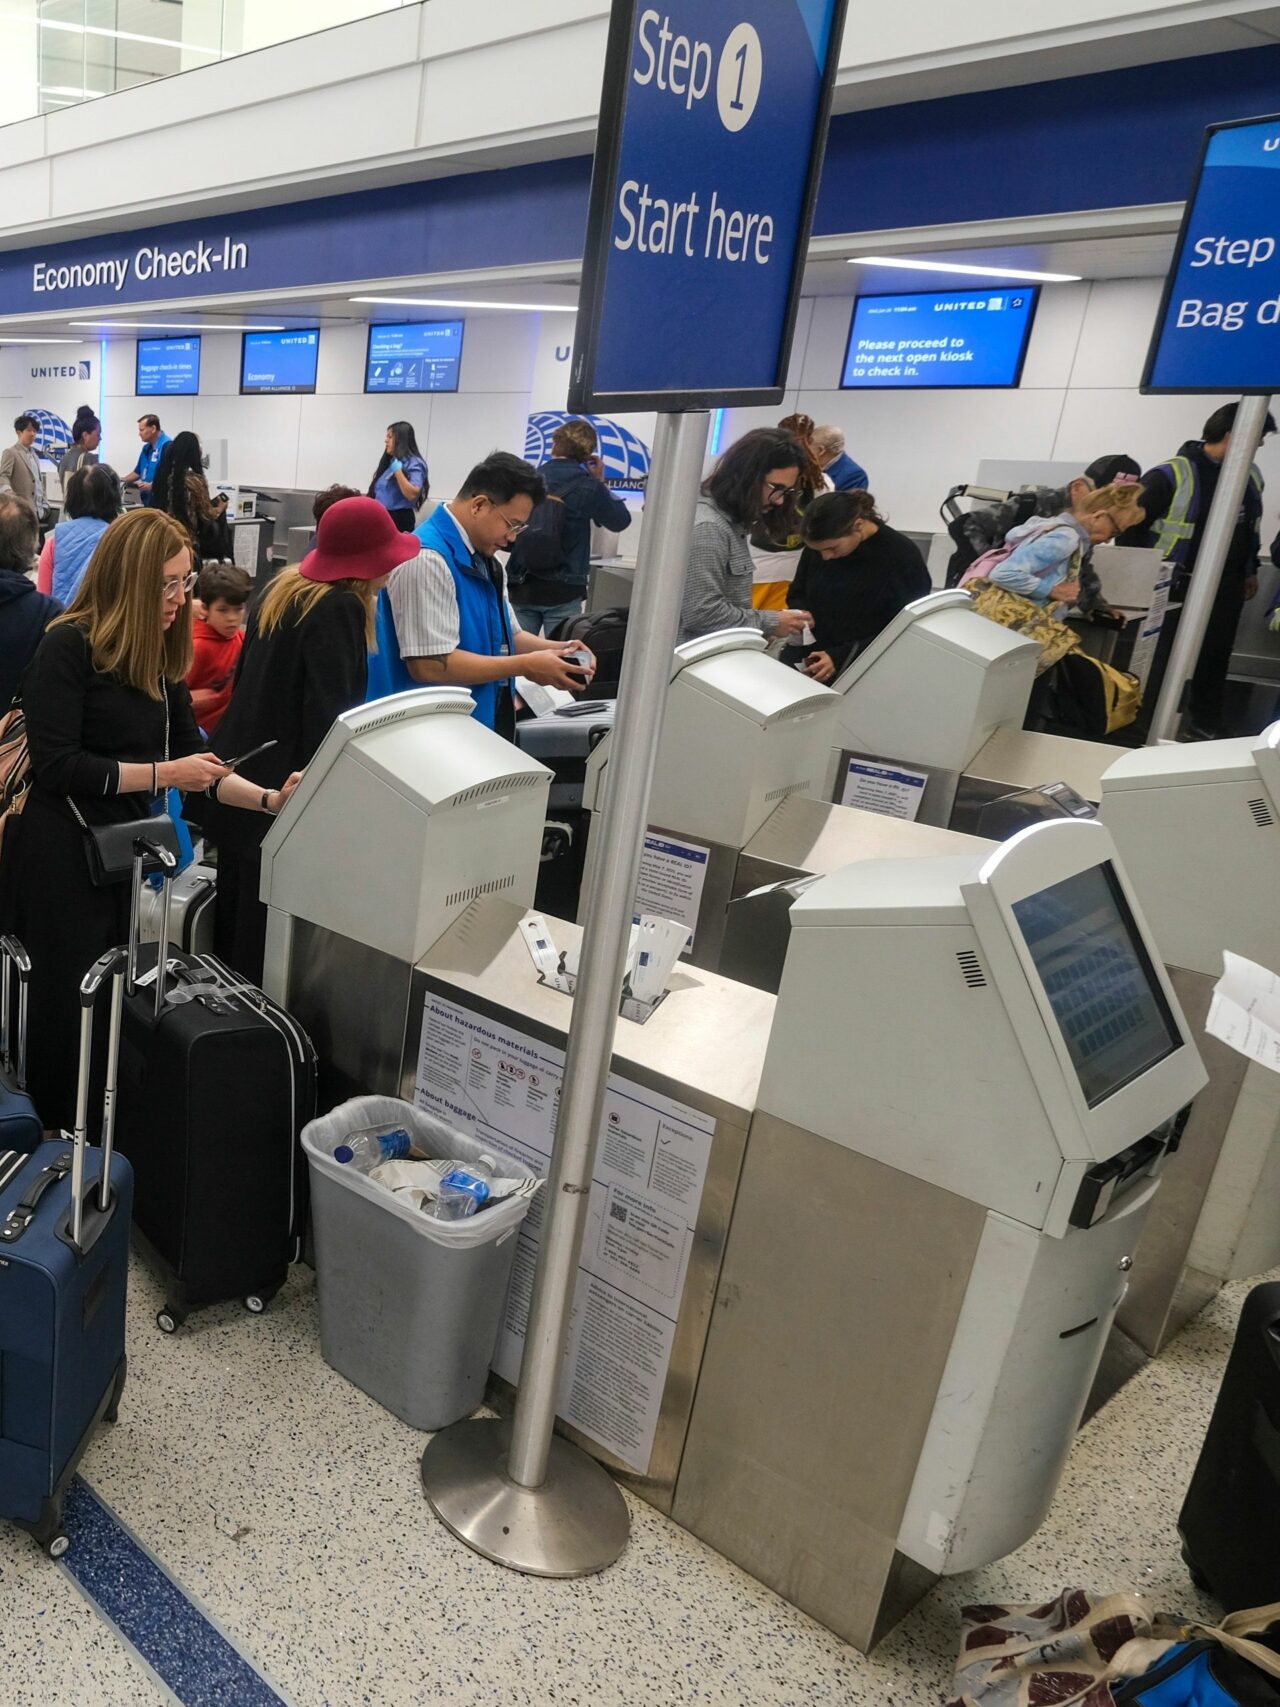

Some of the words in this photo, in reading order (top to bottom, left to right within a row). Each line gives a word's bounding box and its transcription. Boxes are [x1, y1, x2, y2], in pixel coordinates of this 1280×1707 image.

[634, 9, 712, 110] Step
[730, 43, 748, 111] 1
[614, 180, 700, 258] Start
[704, 191, 774, 264] here
[1190, 235, 1275, 268] Step
[33, 257, 129, 292] Economy
[134, 237, 248, 281] Check-In
[934, 302, 986, 312] UNITED
[1176, 299, 1248, 331] Bag
[281, 337, 307, 345] UNITED
[858, 339, 896, 350] Please
[898, 337, 947, 351] proceed
[950, 337, 964, 348] to
[855, 353, 874, 363] the
[877, 353, 904, 363] next
[905, 352, 937, 365] open
[939, 351, 974, 362] kiosk
[31, 366, 76, 378] UNITED
[248, 373, 275, 382] Economy
[852, 367, 865, 377] to
[867, 365, 901, 376] check
[904, 365, 919, 376] in.
[430, 1004, 453, 1021] About
[455, 1015, 496, 1040] hazardous
[498, 1036, 539, 1059] materials
[420, 1088, 443, 1104] About
[444, 1099, 477, 1121] baggage
